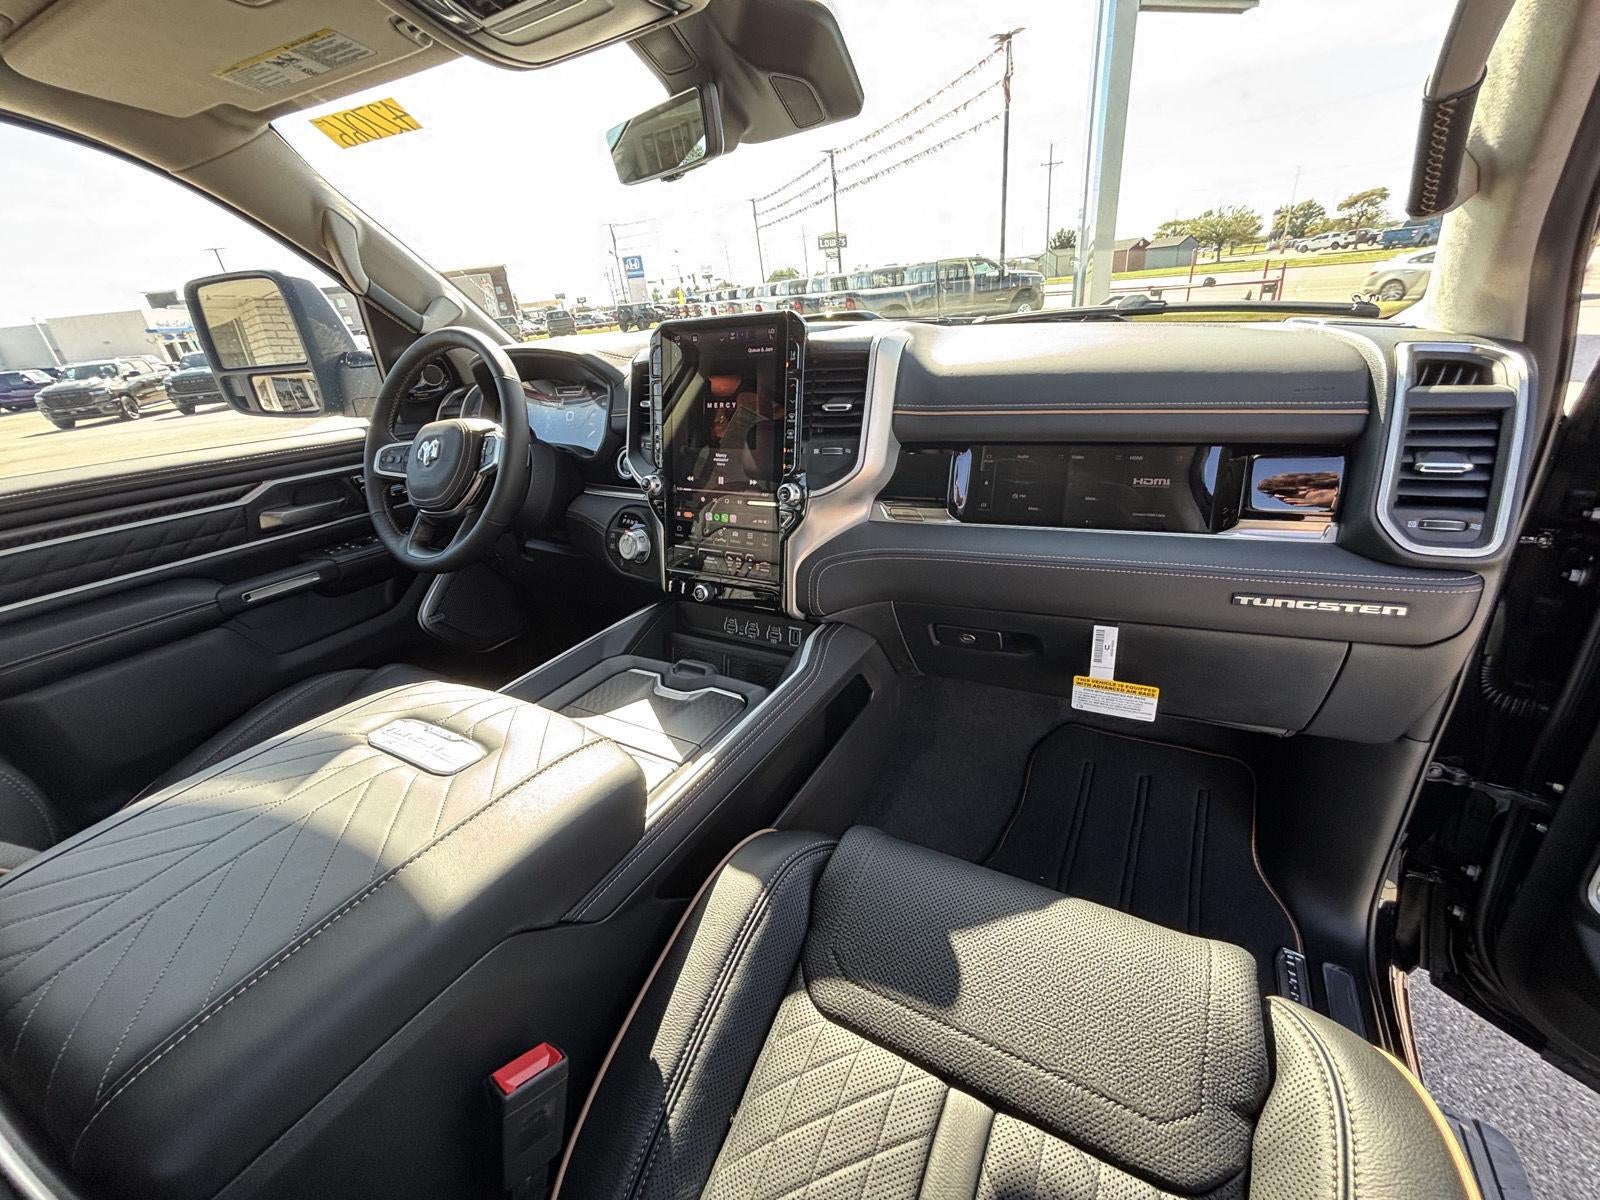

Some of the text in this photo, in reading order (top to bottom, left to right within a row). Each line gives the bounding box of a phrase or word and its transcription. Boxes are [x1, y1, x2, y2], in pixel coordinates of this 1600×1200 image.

[1132, 477, 1171, 486] HDMI
[1234, 595, 1408, 617] TUNGSTEN
[1091, 679, 1116, 687] VEHICLE
[1125, 684, 1157, 693] EQUIPPED
[1093, 684, 1126, 693] ADVANCED
[1138, 690, 1155, 698] BAGS
